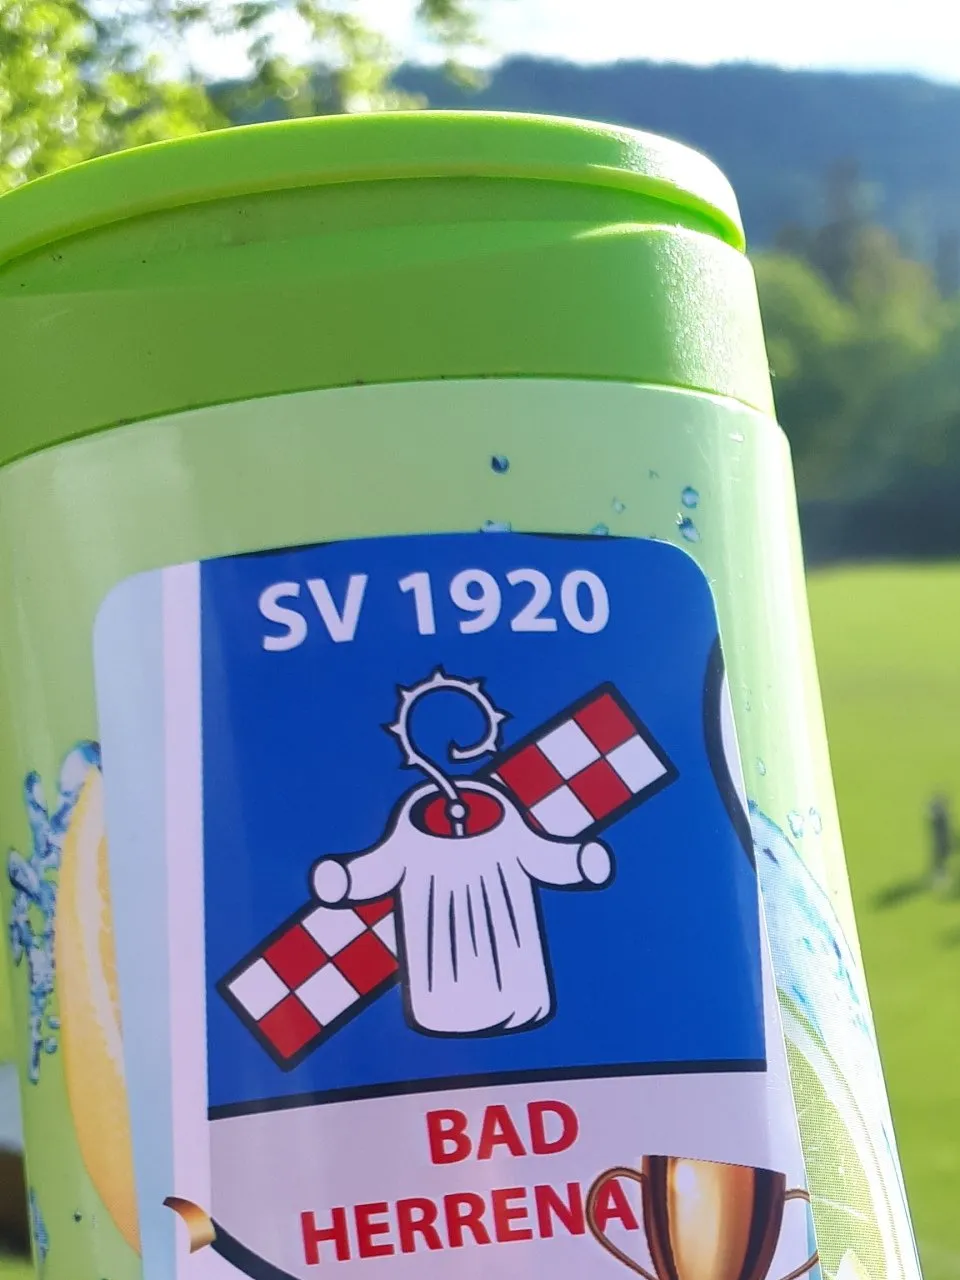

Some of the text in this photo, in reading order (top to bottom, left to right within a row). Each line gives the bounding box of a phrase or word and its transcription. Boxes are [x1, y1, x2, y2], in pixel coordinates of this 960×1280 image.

[258, 568, 610, 652] SV 1920
[425, 1098, 580, 1165] BAD
